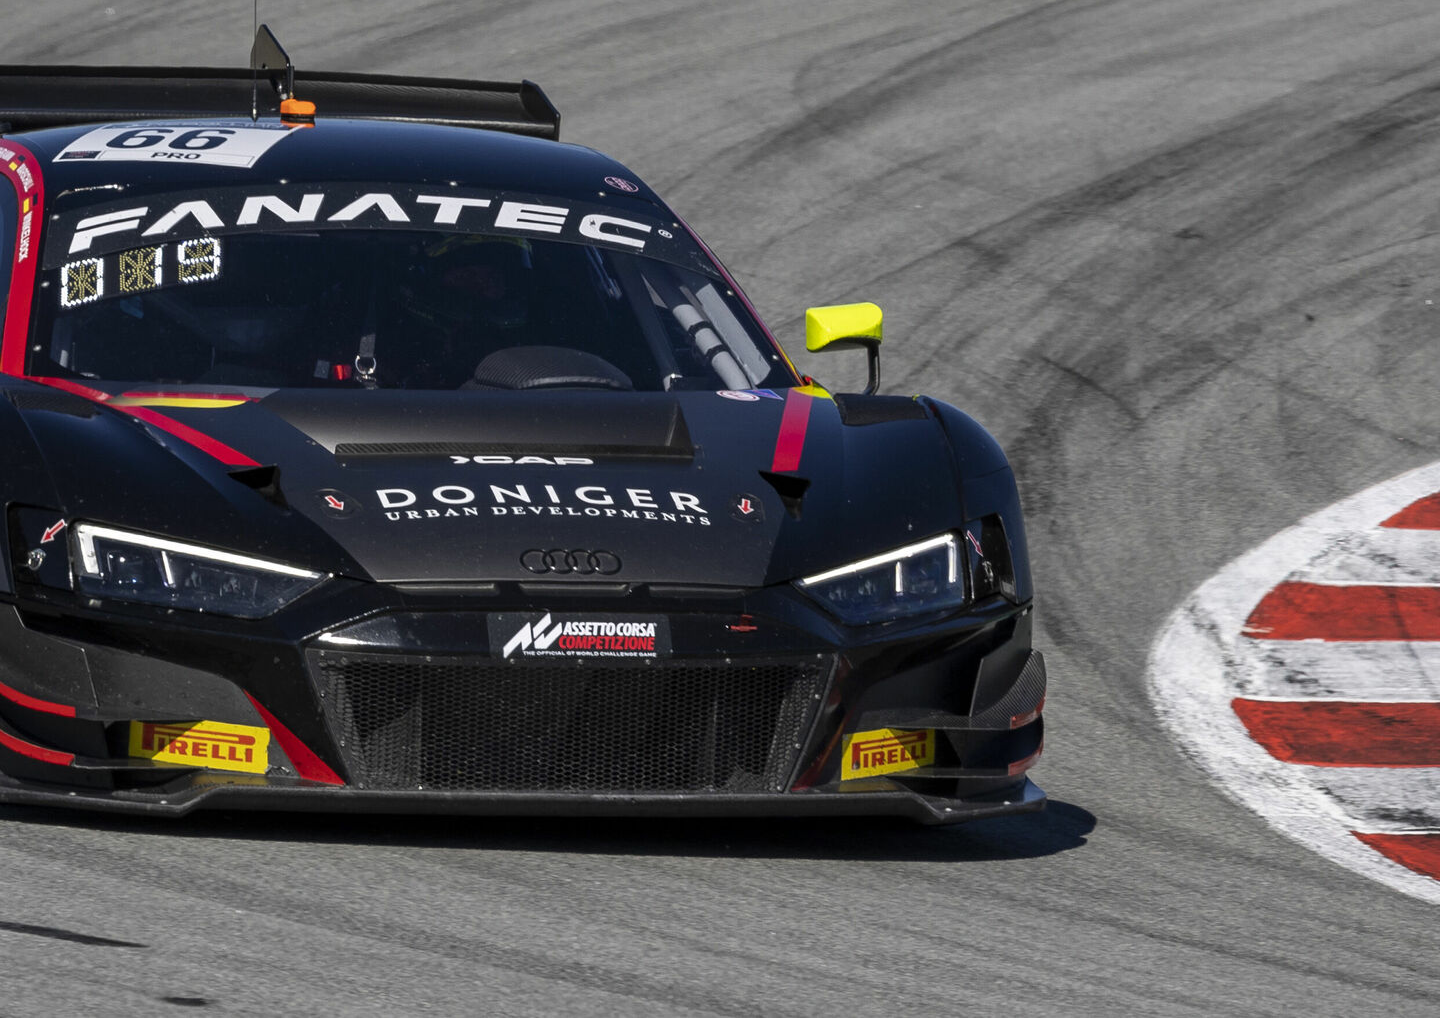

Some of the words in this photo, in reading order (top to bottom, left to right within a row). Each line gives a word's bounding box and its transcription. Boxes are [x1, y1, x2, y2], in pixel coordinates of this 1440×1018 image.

[105, 127, 237, 151] 66
[151, 151, 202, 161] PRO
[68, 192, 653, 255] FANATEC
[375, 484, 710, 515] DONIGER
[383, 505, 480, 522] URBAN
[490, 505, 713, 527] DEVELOPMENTS
[563, 621, 616, 637] ASSETTO
[616, 622, 657, 638] CORSA
[558, 635, 655, 651] COMPETIZIONE
[142, 723, 256, 765] PIRELLI
[851, 731, 928, 770] PIRELLI
